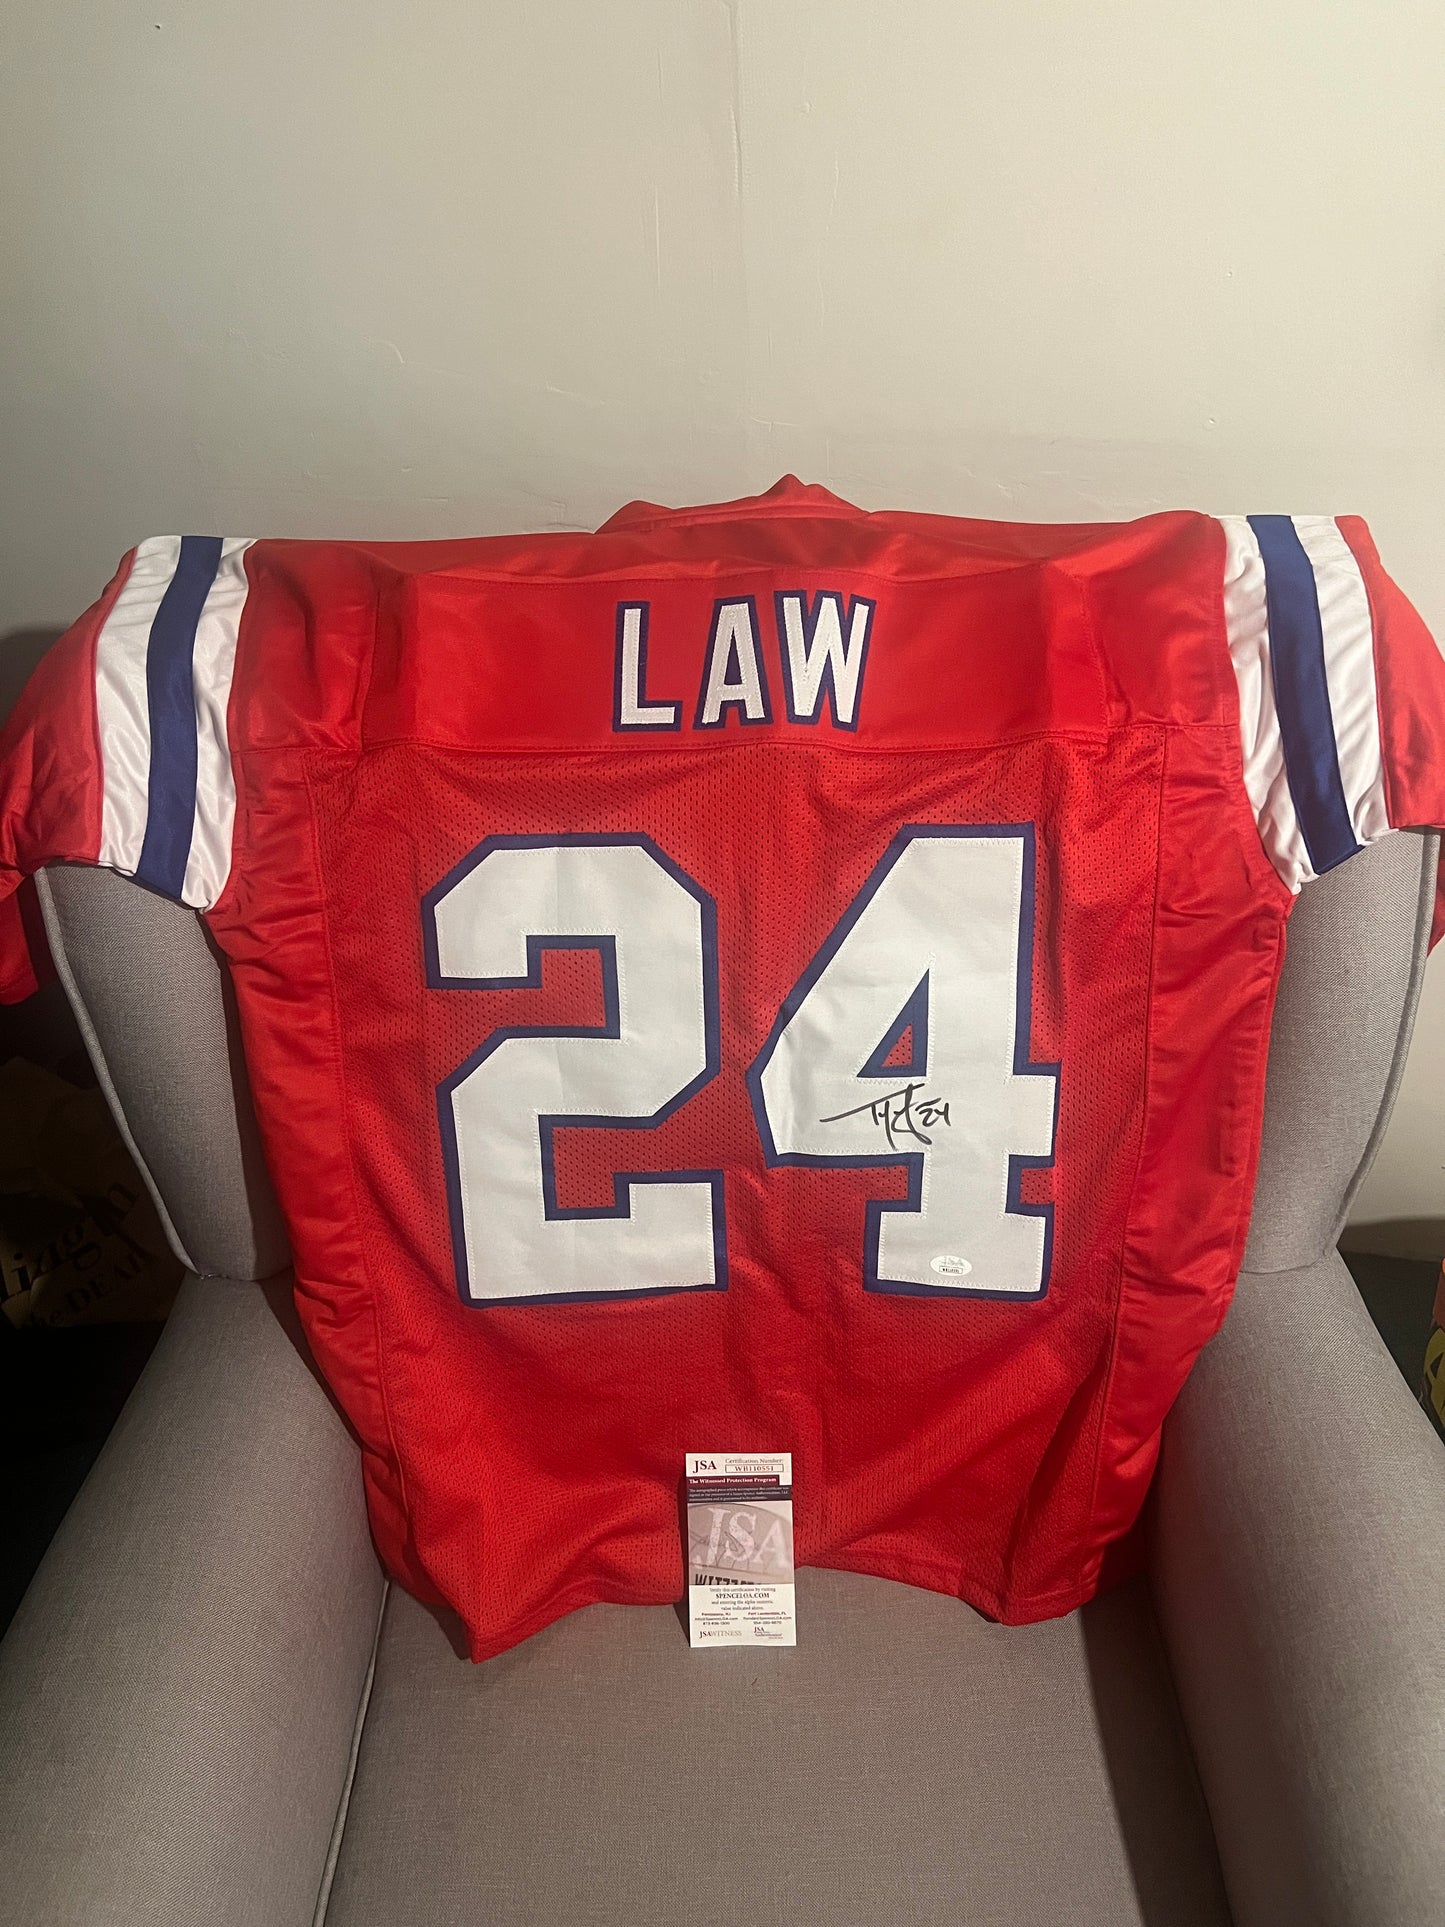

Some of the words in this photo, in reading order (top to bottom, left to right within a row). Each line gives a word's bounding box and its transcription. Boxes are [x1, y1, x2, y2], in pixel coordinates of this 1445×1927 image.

[613, 591, 876, 732] LAW
[421, 822, 1061, 1308] 24
[692, 1460, 717, 1473] JSA
